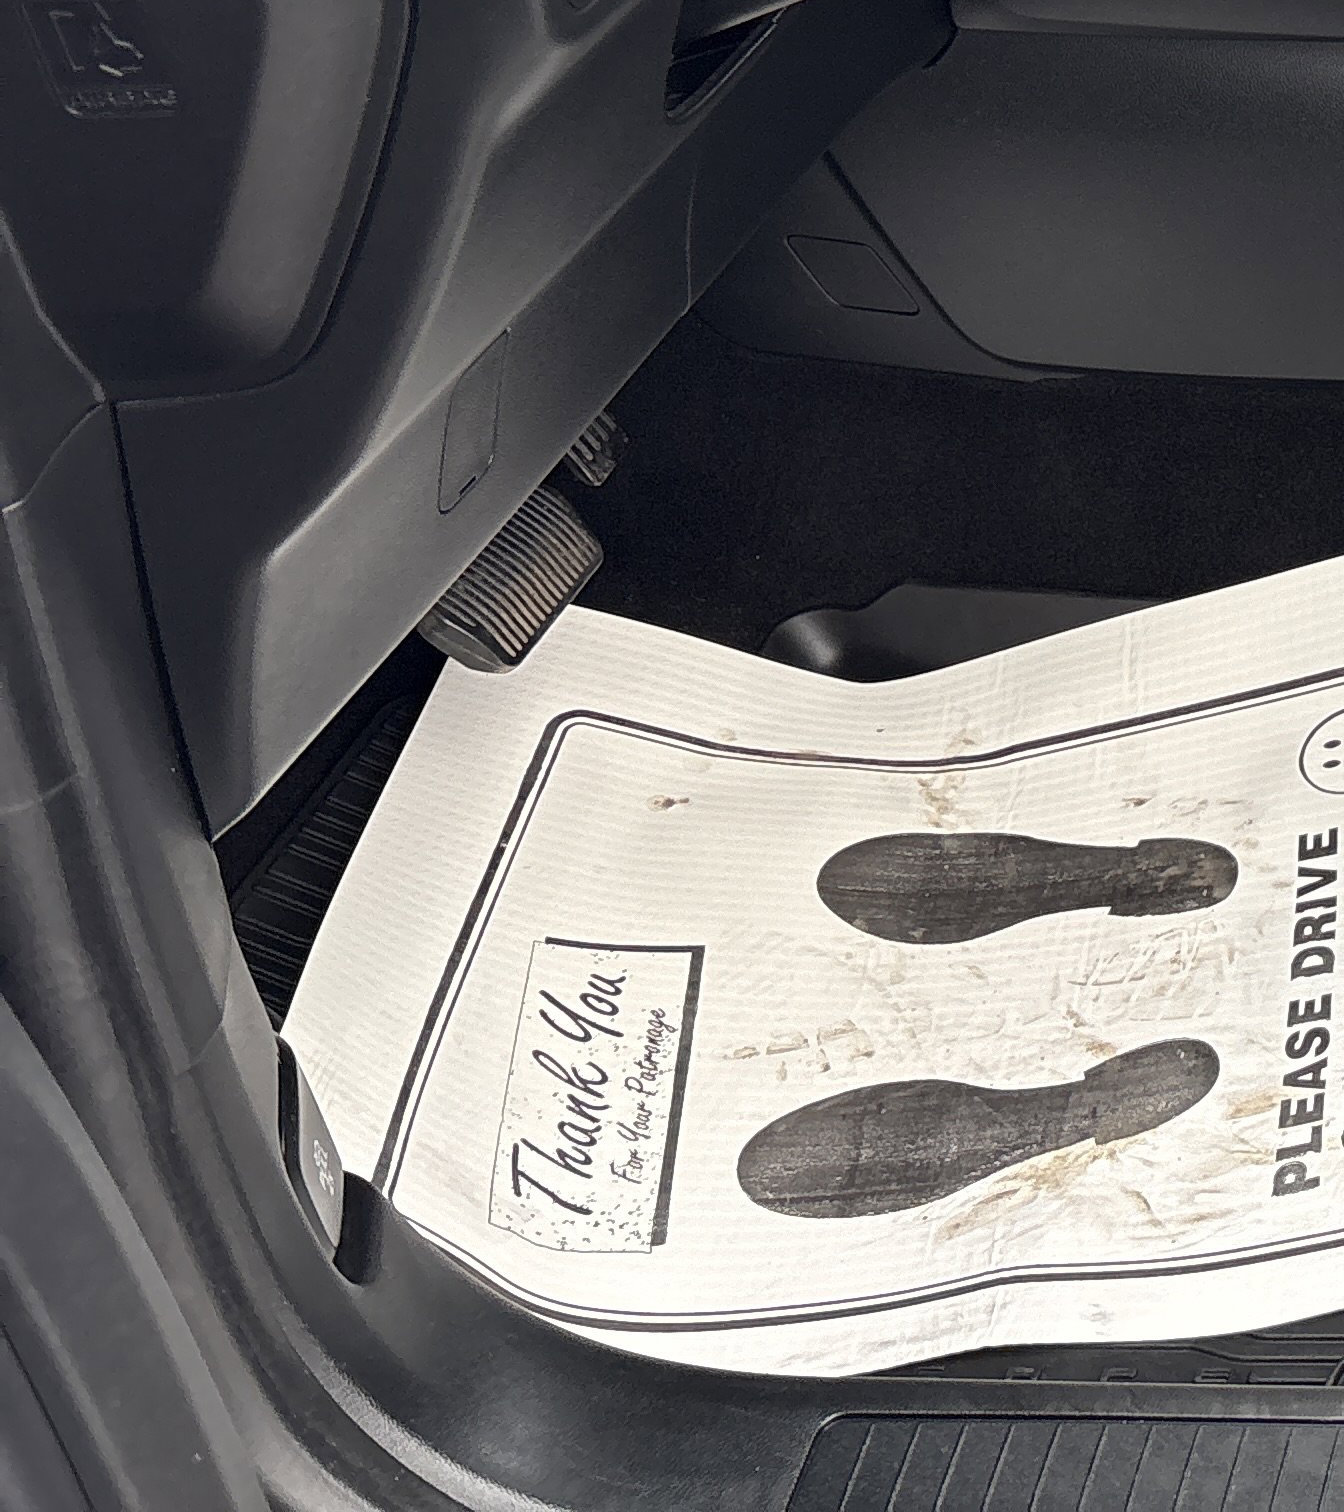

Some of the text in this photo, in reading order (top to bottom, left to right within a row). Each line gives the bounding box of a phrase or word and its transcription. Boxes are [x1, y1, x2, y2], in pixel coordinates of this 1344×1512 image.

[511, 972, 627, 1215] Thank You
[610, 1007, 679, 1185] For Your Patronage
[1270, 826, 1340, 1198] PLEASE DRIVE
